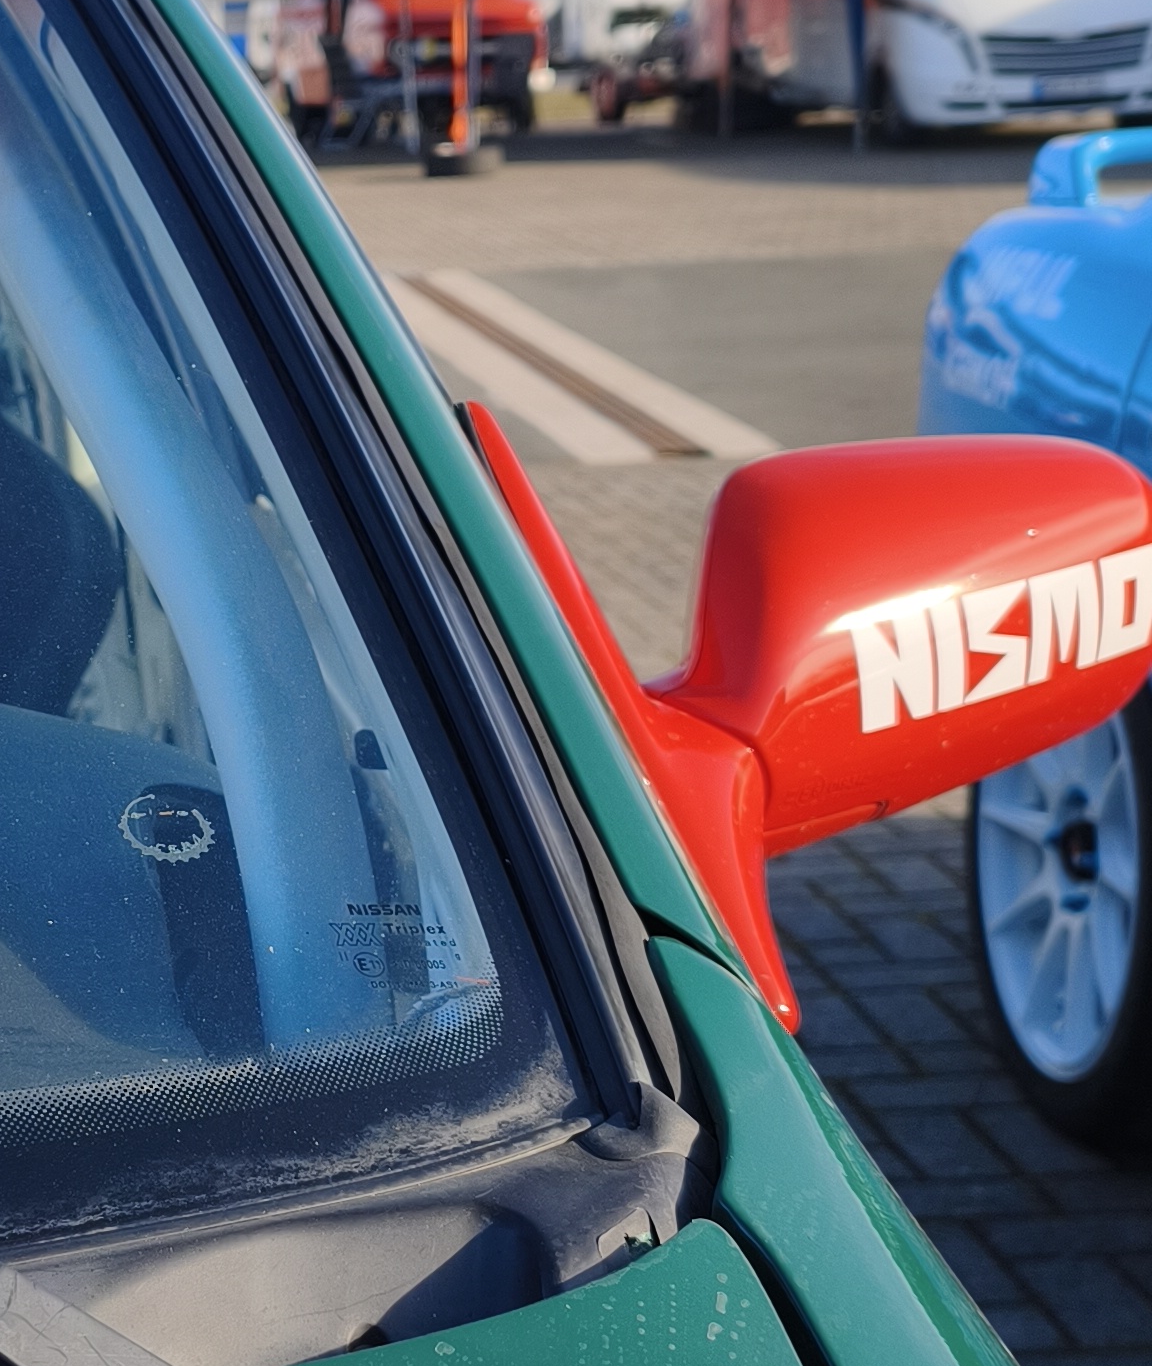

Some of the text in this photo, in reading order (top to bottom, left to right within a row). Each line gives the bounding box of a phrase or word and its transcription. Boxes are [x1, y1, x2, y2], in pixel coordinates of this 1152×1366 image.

[849, 542, 1152, 734] NISMO
[347, 903, 422, 916] NISSAN
[383, 923, 447, 936] Triplex
